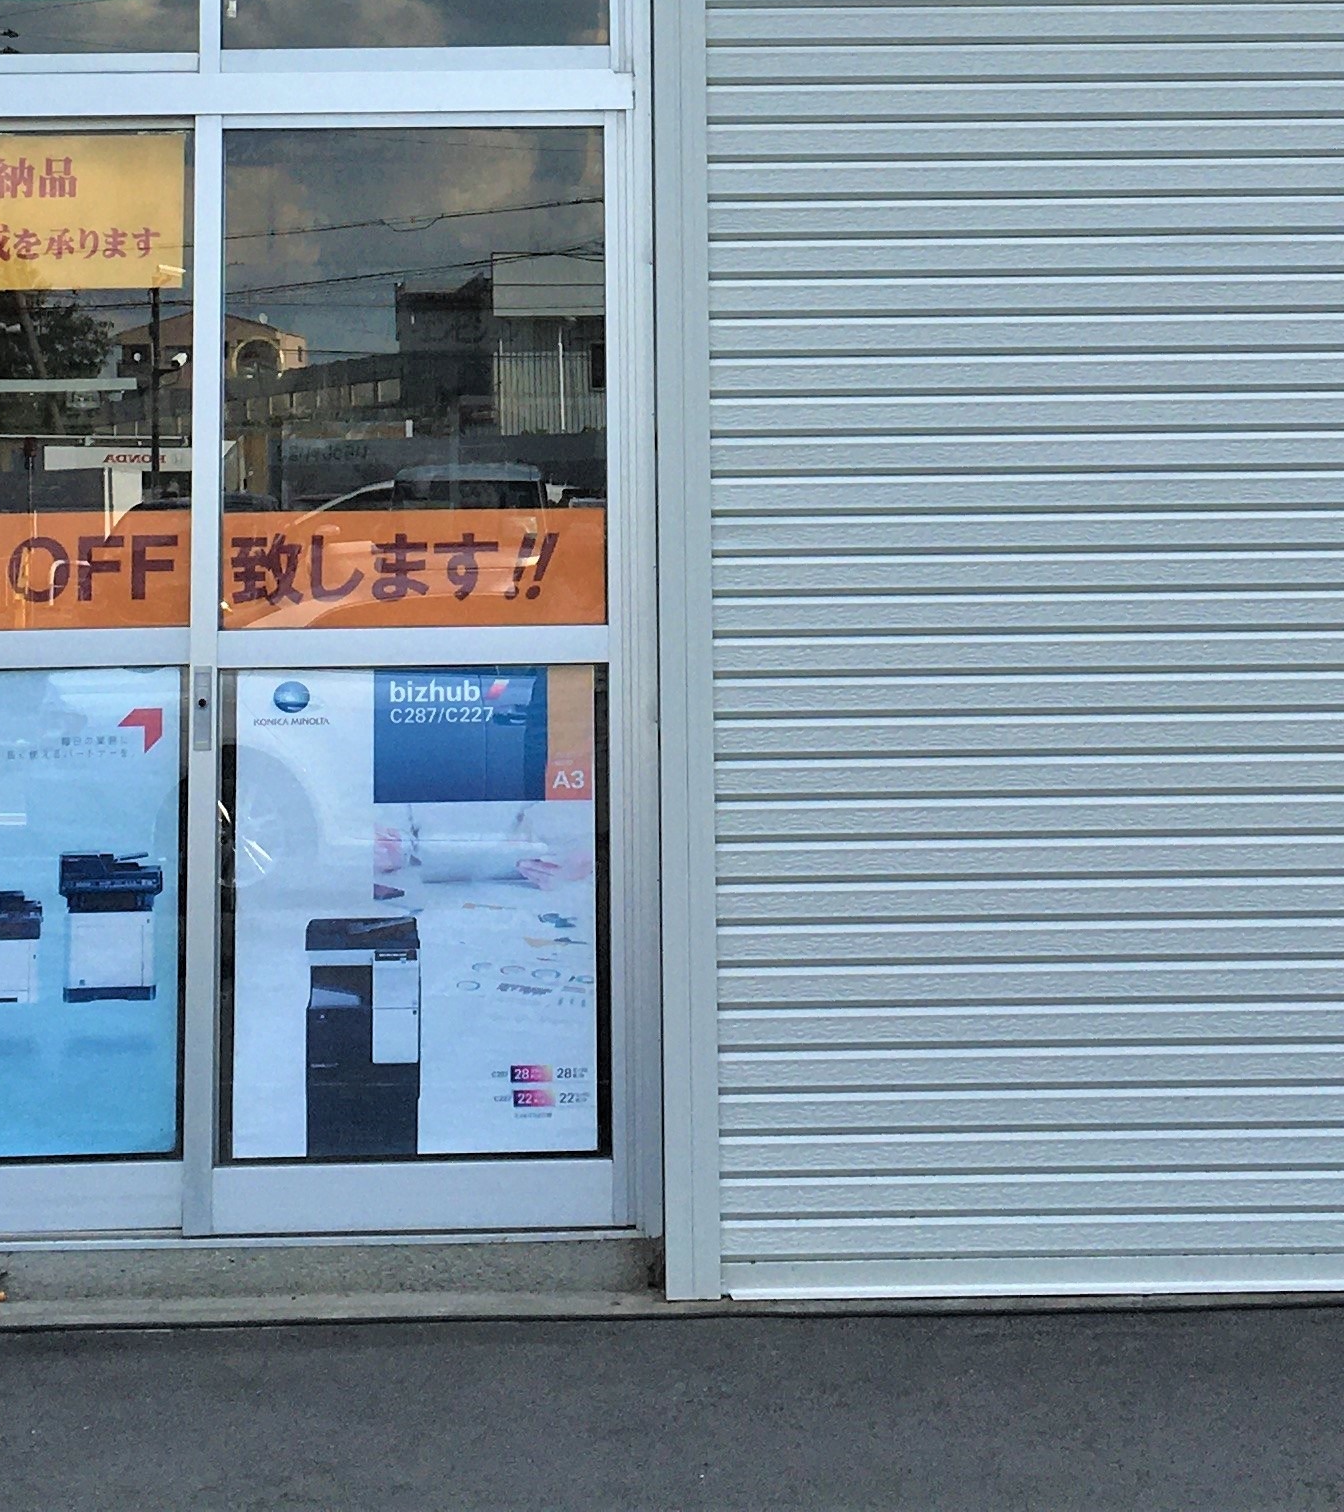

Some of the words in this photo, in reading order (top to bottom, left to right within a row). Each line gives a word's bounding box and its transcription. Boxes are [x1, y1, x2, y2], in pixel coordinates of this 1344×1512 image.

[390, 679, 480, 702] bizhub
[253, 717, 289, 726] KONICA
[290, 717, 331, 726] MINOLTA
[390, 706, 494, 724] C287/C227
[553, 770, 584, 789] A3
